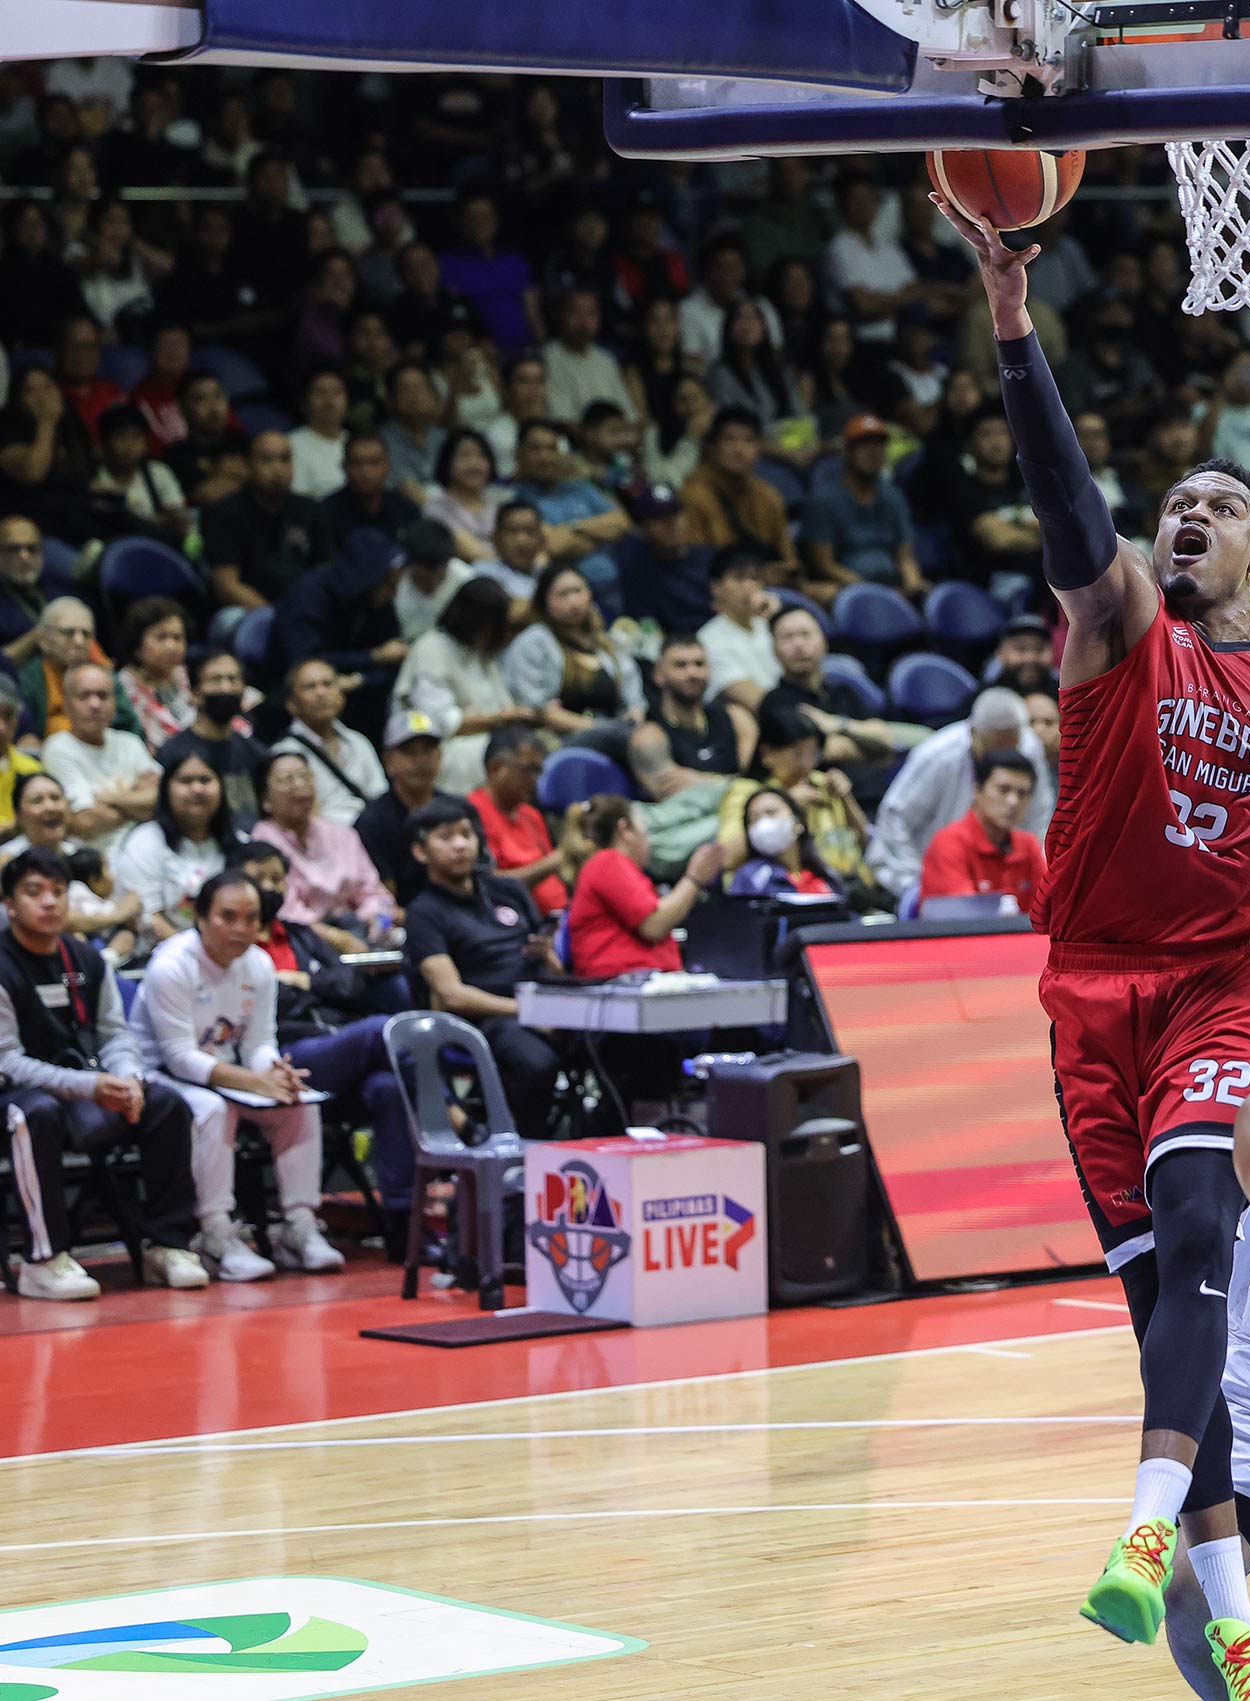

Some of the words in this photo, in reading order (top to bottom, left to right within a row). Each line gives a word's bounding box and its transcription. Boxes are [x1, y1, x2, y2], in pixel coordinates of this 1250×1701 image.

[1164, 790, 1229, 857] 32
[545, 1172, 616, 1229] PBA
[644, 1223, 718, 1272] LIVE
